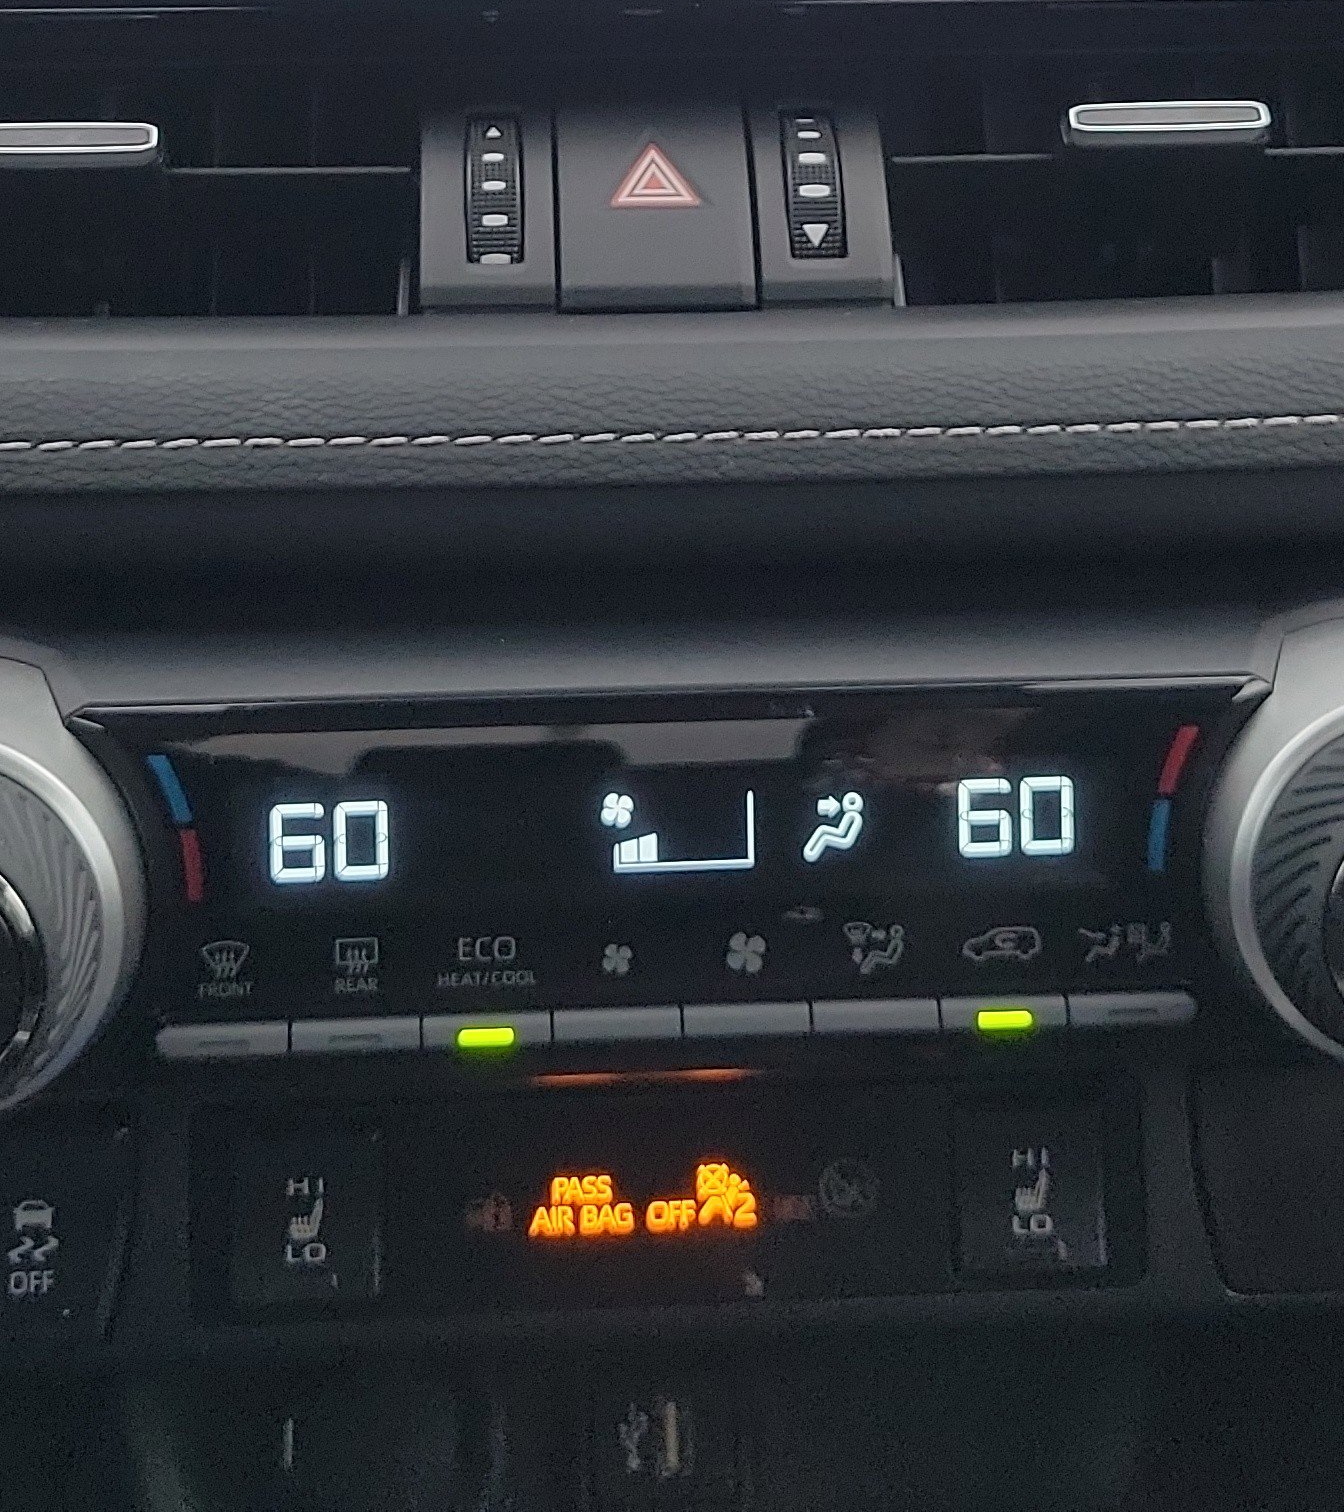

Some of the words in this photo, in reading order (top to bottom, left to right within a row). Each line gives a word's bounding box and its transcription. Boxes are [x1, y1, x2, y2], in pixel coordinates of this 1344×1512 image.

[957, 775, 1078, 858] 60
[268, 800, 391, 886] 60
[458, 935, 518, 961] ECO
[286, 1176, 325, 1197] HI
[550, 1174, 613, 1207] PASS
[527, 1202, 576, 1239] AIR
[578, 1201, 635, 1236] BAG
[645, 1198, 698, 1233] OFF
[1011, 1213, 1054, 1236] LO
[285, 1241, 328, 1264] LO
[7, 1269, 56, 1294] OFF
